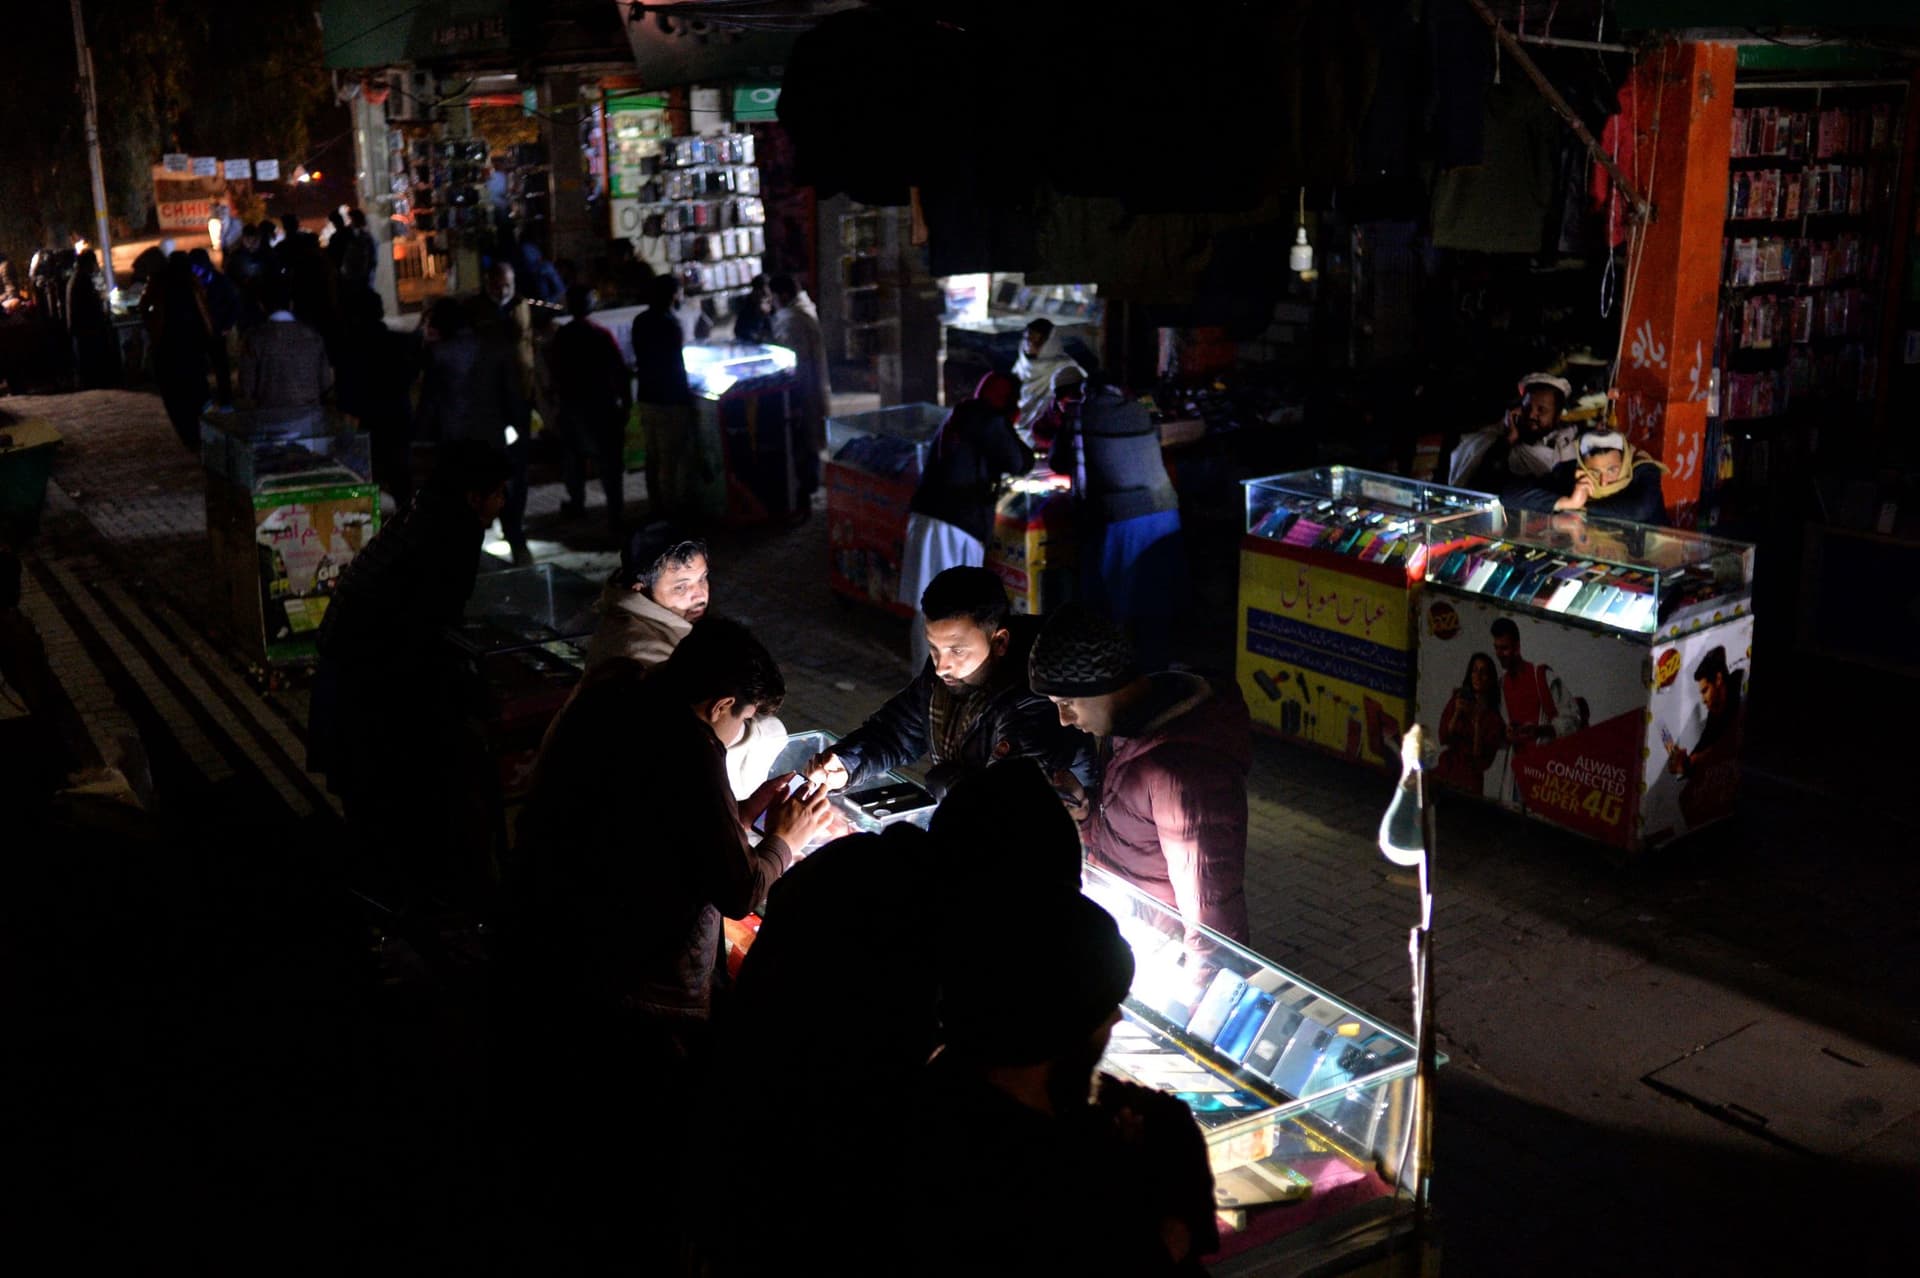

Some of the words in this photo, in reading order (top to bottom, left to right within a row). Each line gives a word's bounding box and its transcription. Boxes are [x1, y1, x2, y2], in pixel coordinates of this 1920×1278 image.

[1523, 765, 1546, 782] WITH
[1543, 774, 1581, 798] JAZZ
[1546, 760, 1626, 798] CONNECTED
[1575, 754, 1627, 783] ALWAYS
[1530, 783, 1581, 817] SUPER
[1583, 790, 1624, 827] 4G
